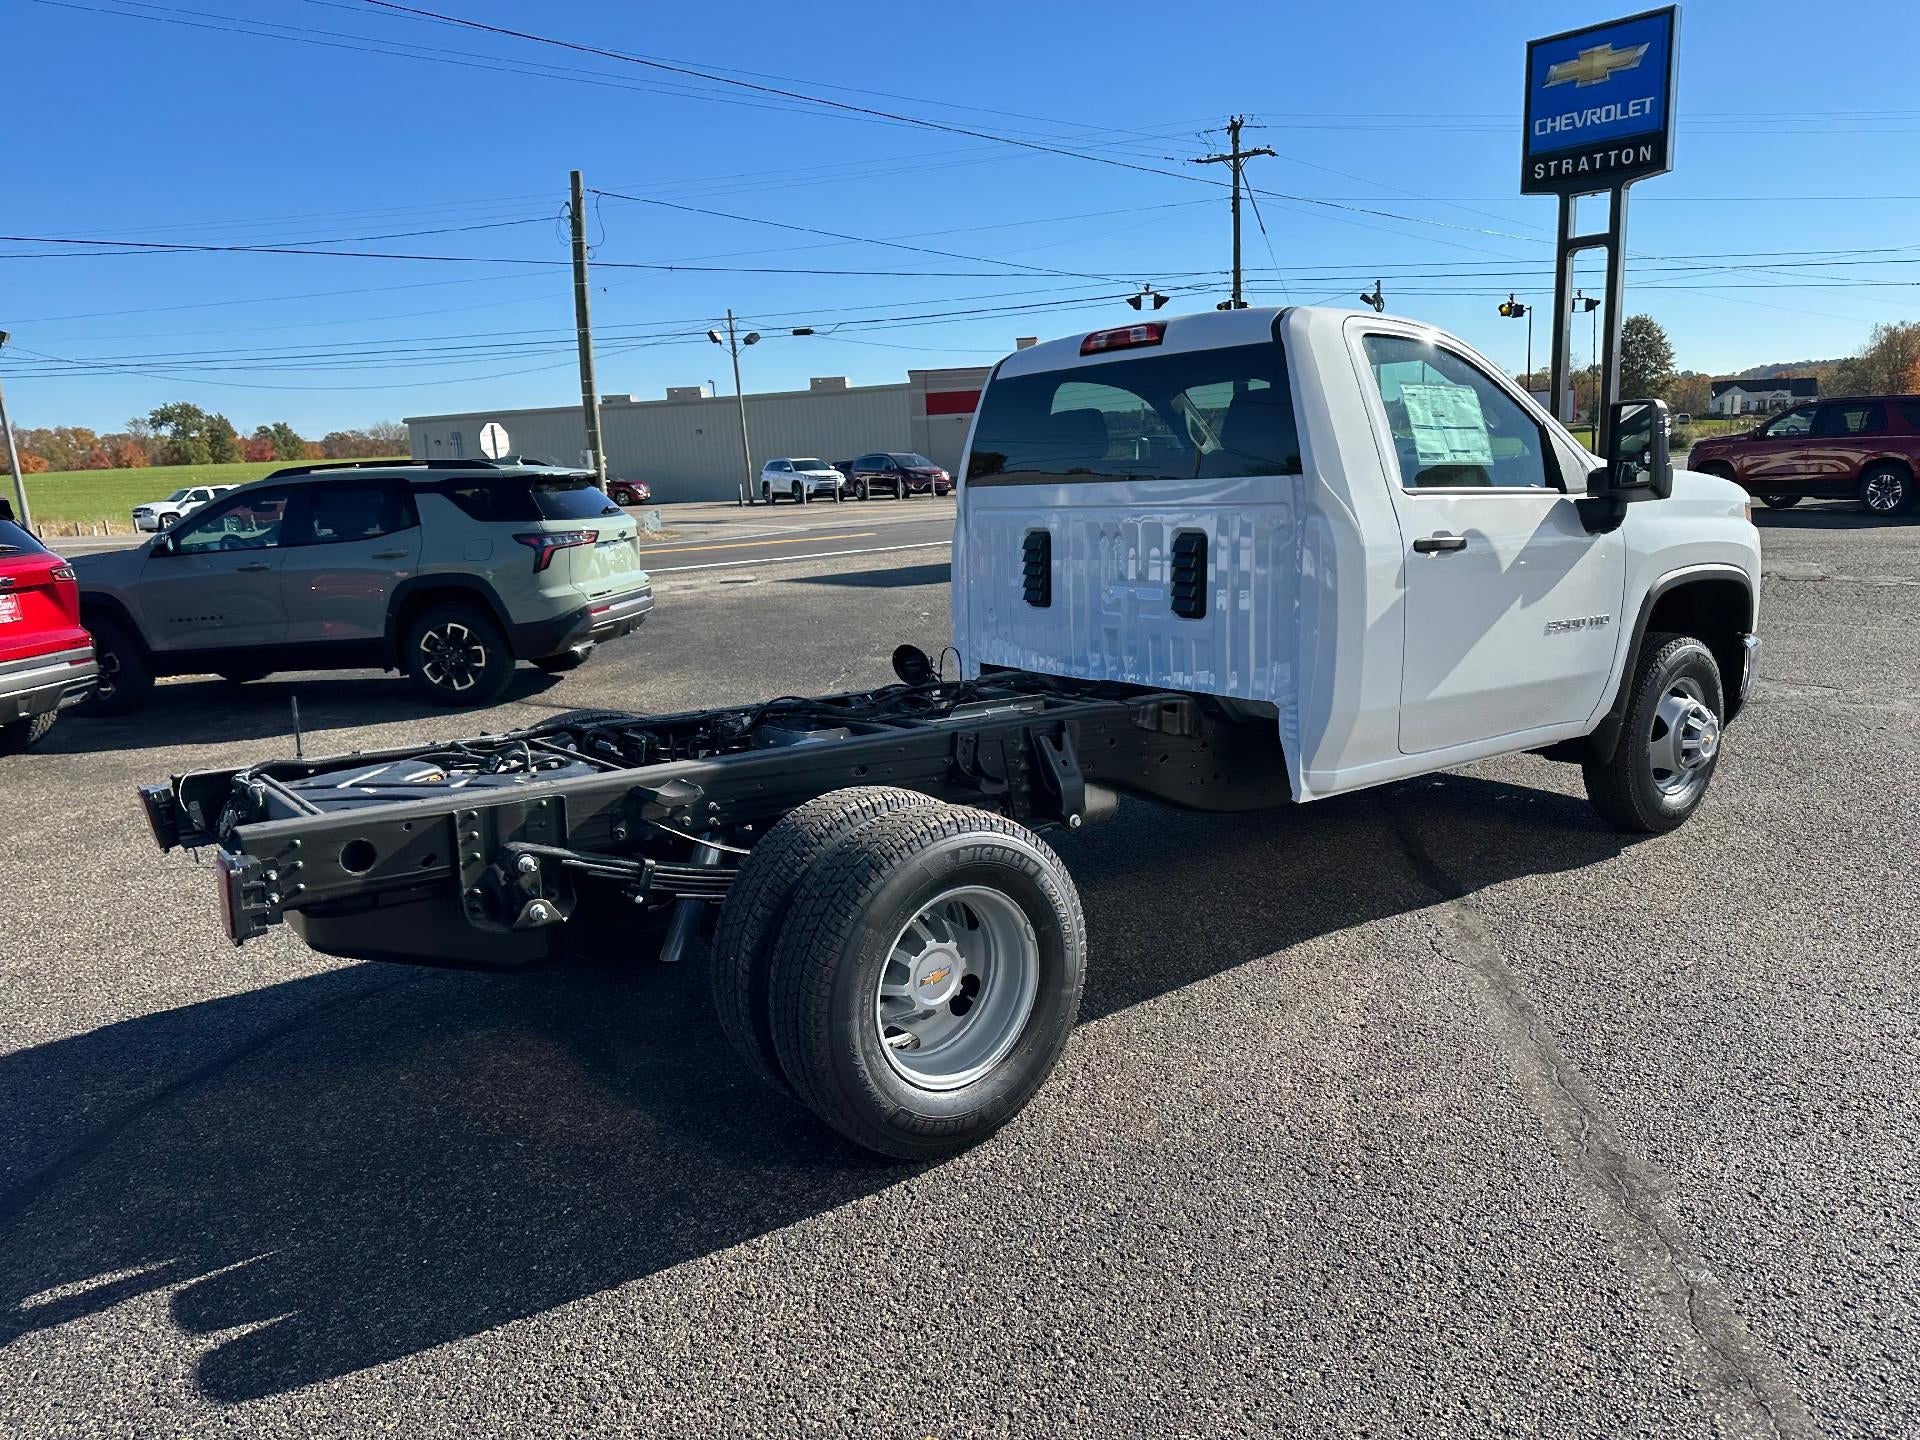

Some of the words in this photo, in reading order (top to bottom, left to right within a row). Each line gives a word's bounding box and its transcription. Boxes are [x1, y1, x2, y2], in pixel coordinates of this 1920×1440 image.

[1535, 96, 1655, 136] CHEVROLET
[1534, 145, 1652, 180] STRATTON
[959, 847, 1042, 877] MICHELIN
